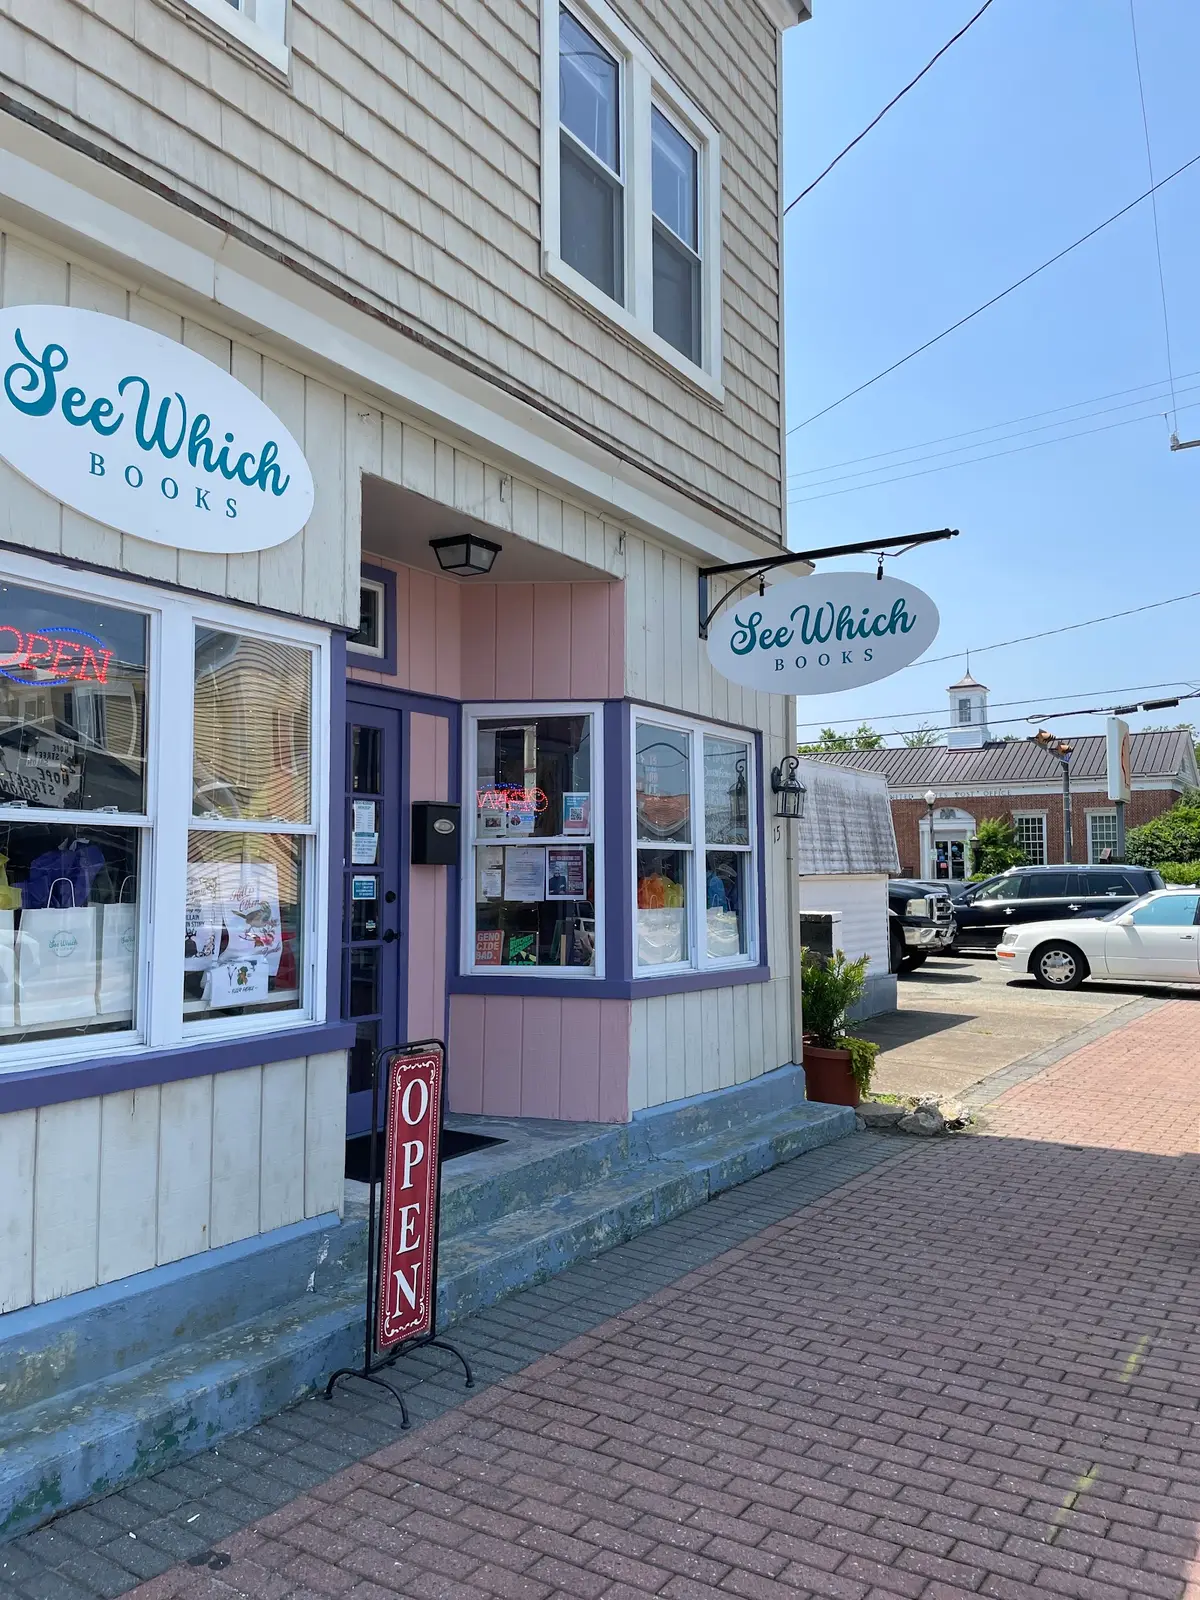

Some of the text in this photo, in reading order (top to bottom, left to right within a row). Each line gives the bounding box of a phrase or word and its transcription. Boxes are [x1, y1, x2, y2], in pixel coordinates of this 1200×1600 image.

[4, 328, 290, 496] See Which
[89, 452, 237, 518] BOOKS
[0, 625, 114, 684] OPEN
[730, 598, 917, 655] See Which
[774, 648, 873, 671] BOOKS
[476, 942, 500, 951] CIDE
[477, 932, 500, 941] GENO
[392, 1078, 429, 1319] OPEN
